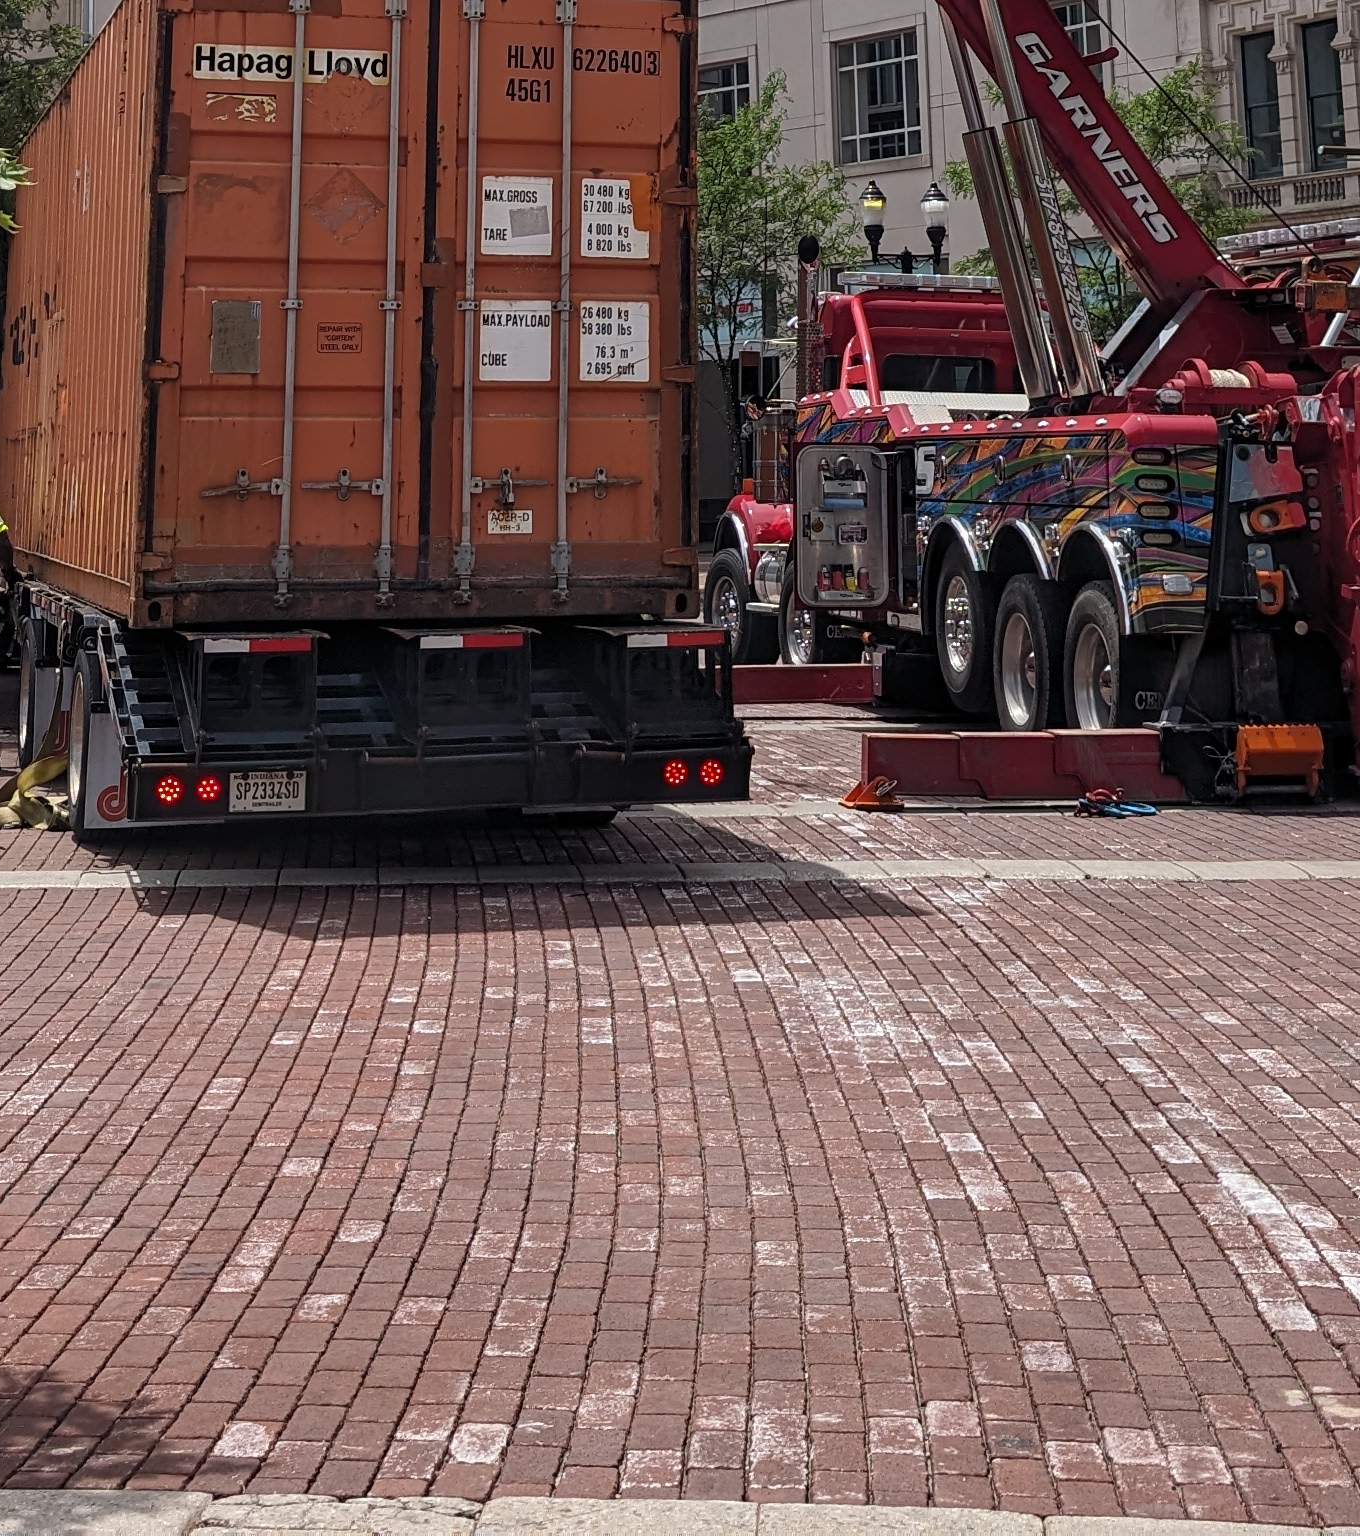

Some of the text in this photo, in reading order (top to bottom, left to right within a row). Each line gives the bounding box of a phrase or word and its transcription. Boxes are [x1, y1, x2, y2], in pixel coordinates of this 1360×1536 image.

[507, 44, 555, 70] HLXU
[505, 77, 551, 103] 45G1
[1015, 32, 1179, 244] GARNERS
[484, 189, 538, 204] MAX.GROSS
[596, 185, 614, 198] 480
[618, 186, 630, 200] kg
[583, 201, 633, 214] 67 200 lbs
[483, 228, 508, 241] TARE
[617, 224, 630, 238] kg
[617, 240, 632, 252] lbs
[482, 314, 551, 328] MAX.PAYLOAD
[595, 307, 613, 319] 480
[617, 307, 630, 321] kg
[319, 325, 361, 333] REPAIR WITH
[595, 323, 613, 336] 380
[617, 324, 632, 336] lbs
[320, 343, 340, 351] STEEL
[481, 353, 508, 367] CUBE
[595, 346, 616, 359] 76.3
[595, 362, 612, 375] 695
[250, 773, 286, 781] INDIANA
[235, 780, 300, 801] SP233ZSD
